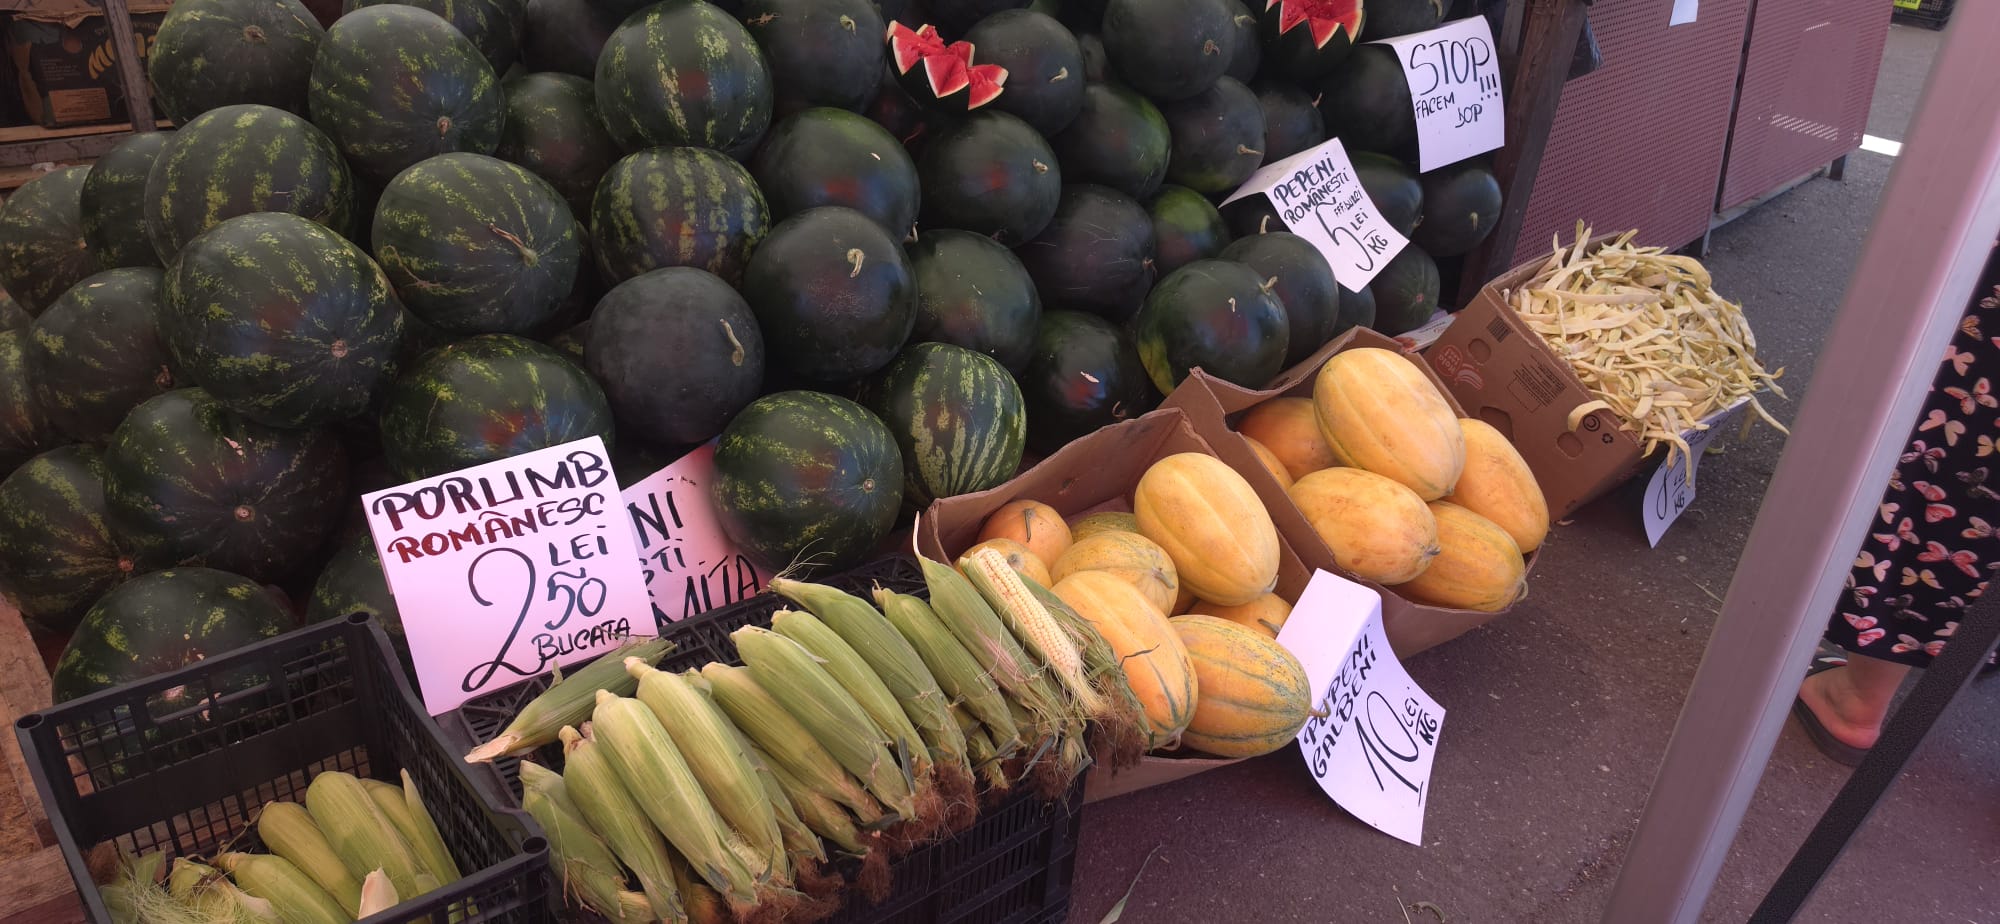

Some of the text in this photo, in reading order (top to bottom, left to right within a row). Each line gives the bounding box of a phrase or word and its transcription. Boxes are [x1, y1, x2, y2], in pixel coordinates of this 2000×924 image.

[1410, 37, 1490, 96] STOP
[1415, 91, 1455, 119] FACEM
[1273, 151, 1336, 207] PEPENI
[1315, 196, 1374, 272] 5
[1367, 235, 1389, 255] KG
[372, 450, 610, 531] PORUMB
[627, 478, 684, 549] NI
[387, 492, 606, 564] ROMÂNESC
[461, 547, 546, 693] 2
[545, 566, 608, 631] 50
[1312, 641, 1377, 779] GALBENI
[1419, 712, 1438, 746] KG
[1353, 690, 1424, 807] 10
